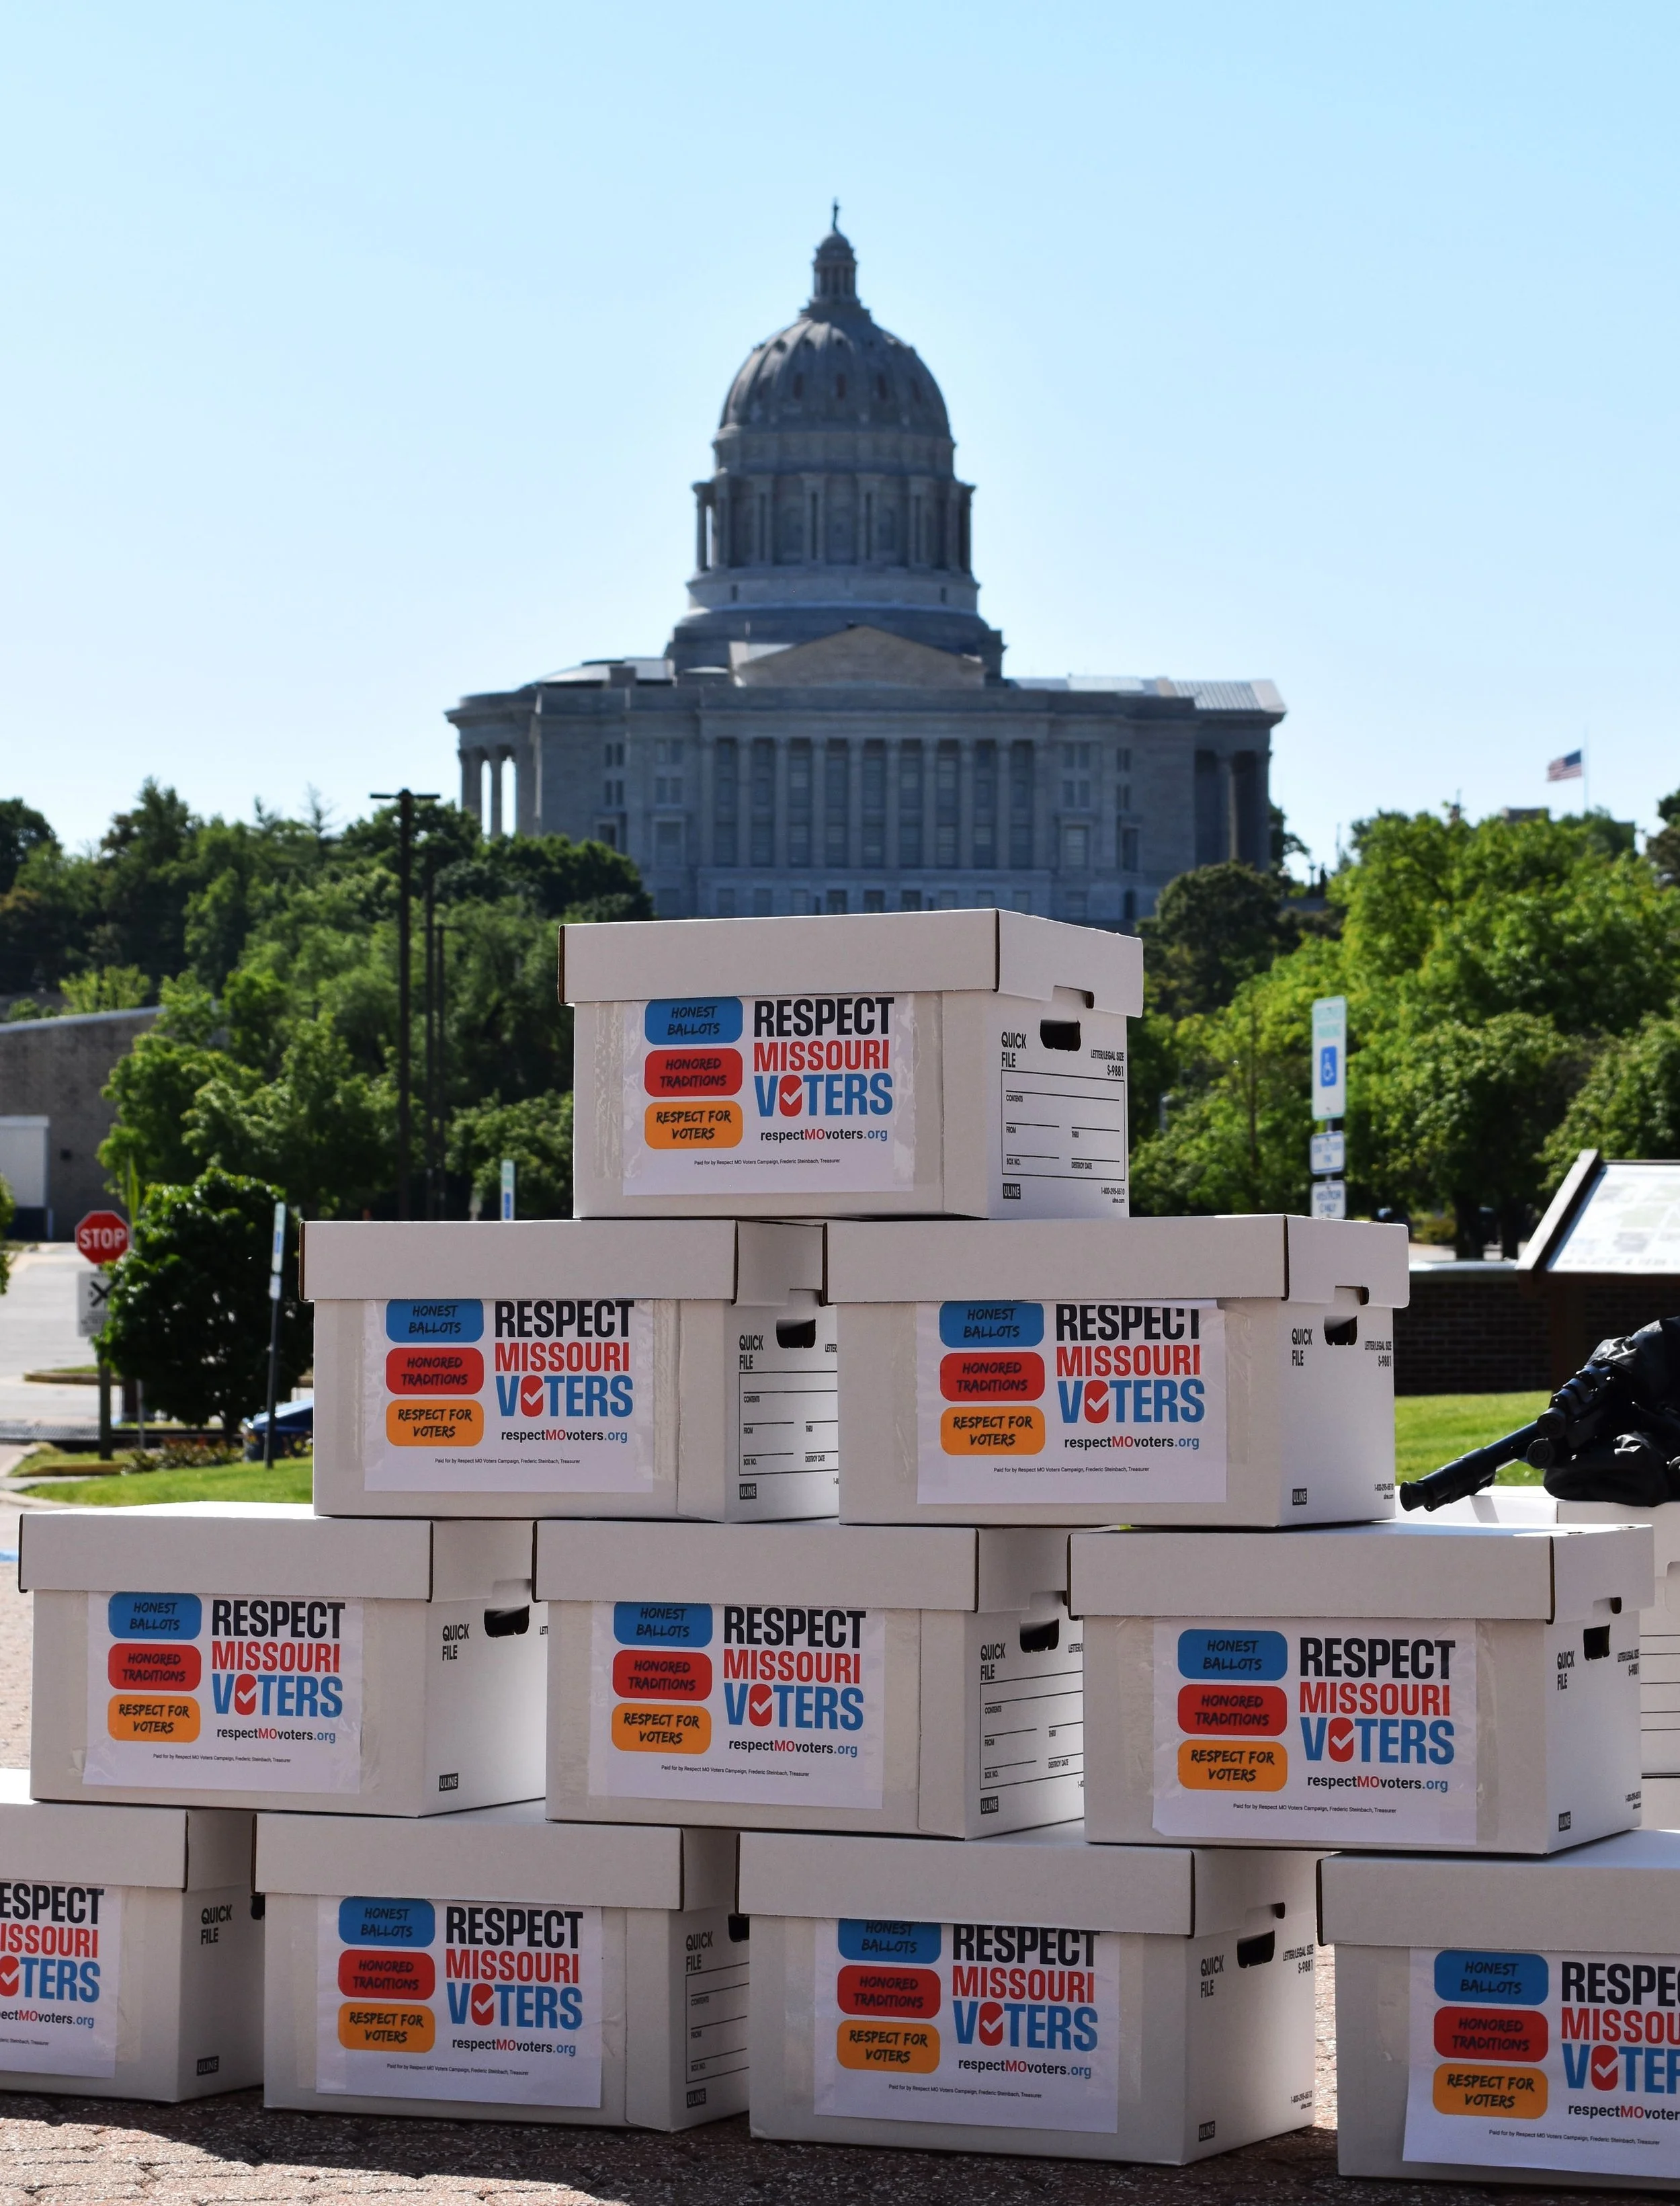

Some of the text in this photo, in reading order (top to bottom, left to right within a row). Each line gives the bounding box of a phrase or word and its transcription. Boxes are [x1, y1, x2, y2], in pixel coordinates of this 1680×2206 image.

[671, 1006, 718, 1018] HONEST
[754, 996, 894, 1038] RESPECT
[667, 1023, 720, 1036] BALLOTS
[1001, 1031, 1027, 1049] QUICK
[754, 1039, 889, 1072] MISSOURI
[1001, 1052, 1016, 1068] FILE
[1091, 1049, 1124, 1061] LETTER/LEGAL SIZE
[665, 1058, 722, 1071] HONORED
[1107, 1065, 1124, 1077] S-9881
[660, 1075, 726, 1090] TRADITIONS
[754, 1072, 893, 1117] VOTERS
[1006, 1094, 1023, 1102] CONTENTS
[656, 1110, 731, 1124] RESPECT FOR
[671, 1127, 714, 1140] VOTERS
[760, 1129, 887, 1141] respectMOvoters.org
[1003, 1185, 1020, 1197] ULINE
[79, 1228, 126, 1250] STOP
[413, 1305, 459, 1317] HONEST
[495, 1300, 634, 1338] RESPECT
[968, 1307, 1017, 1321] HONEST
[409, 1322, 461, 1334] BALLOTS
[964, 1325, 1020, 1338] BALLOTS
[739, 1335, 763, 1351] QUICK
[1292, 1328, 1312, 1346] QUICK
[407, 1357, 462, 1369] HONORED
[495, 1342, 629, 1372] MISSOURI
[739, 1354, 753, 1370] FILE
[1056, 1344, 1200, 1377] MISSOURI
[1292, 1350, 1304, 1366] FILE
[962, 1362, 1022, 1375] HONORED
[401, 1374, 468, 1387] TRADITIONS
[956, 1379, 1027, 1393] TRADITIONS
[495, 1375, 633, 1418] VOTERS
[1056, 1379, 1205, 1424] VOTERS
[397, 1409, 472, 1422] RESPECT FOR
[953, 1416, 1033, 1430] RESPECT FOR
[413, 1426, 456, 1438] VOTERS
[501, 1429, 627, 1443] respectMOvoters.org
[969, 1434, 1015, 1446] VOTERS
[1064, 1436, 1200, 1450] respectMOvoters.org
[740, 1486, 756, 1497] ULINE
[1293, 1491, 1307, 1503] ULINE
[134, 1602, 178, 1615] HONEST
[640, 1608, 687, 1621] HONEST
[130, 1619, 180, 1631] BALLOTS
[212, 1599, 345, 1639] RESPECT
[442, 1623, 470, 1641] QUICK
[636, 1625, 689, 1638] BALLOTS
[724, 1606, 866, 1649] RESPECT
[442, 1645, 458, 1661] FILE
[980, 1643, 1006, 1661] QUICK
[1208, 1639, 1259, 1653] HONEST
[128, 1653, 181, 1666] HONORED
[211, 1641, 339, 1673] MISSOURI
[1203, 1658, 1262, 1671] BALLOTS
[1300, 1637, 1456, 1680] RESPECT
[1557, 1650, 1575, 1670] QUICK
[634, 1660, 691, 1674] HONORED
[723, 1649, 860, 1684] MISSOURI
[980, 1664, 995, 1680] FILE
[122, 1669, 185, 1682] TRADITIONS
[1557, 1673, 1567, 1690] FILE
[628, 1676, 696, 1692] TRADITIONS
[211, 1674, 342, 1718] VOTERS
[1201, 1695, 1263, 1709] HONORED
[1300, 1682, 1450, 1716] MISSOURI
[118, 1703, 190, 1718] RESPECT FOR
[723, 1682, 864, 1731] VOTERS
[133, 1721, 173, 1734] VOTERS
[623, 1712, 700, 1729] RESPECT FOR
[1195, 1712, 1269, 1727] TRADITIONS
[216, 1728, 336, 1744] respectMOvoters.org
[639, 1731, 683, 1745] VOTERS
[1300, 1717, 1454, 1765] VOTERS
[728, 1740, 857, 1758] respectMOvoters.org
[1191, 1749, 1275, 1765] RESPECT FOR
[439, 1776, 458, 1789] ULINE
[1208, 1768, 1256, 1783] VOTERS
[1307, 1776, 1448, 1793] respectMOvoters.org
[981, 1798, 998, 1811] ULINE
[201, 1905, 232, 1924] QUICK
[365, 1908, 410, 1921] HONEST
[361, 1924, 413, 1938] BALLOTS
[446, 1906, 584, 1949] RESPECT
[866, 1923, 915, 1936] HONEST
[201, 1928, 218, 1945] FILE
[685, 1930, 713, 1951] QUICK
[862, 1939, 917, 1954] BALLOTS
[953, 1926, 1100, 1967] RESPECT
[359, 1960, 414, 1973] HONORED
[446, 1949, 579, 1984] MISSOURI
[685, 1954, 702, 1972] FILE
[1200, 1955, 1224, 1977] QUICK
[1466, 1961, 1519, 1977] HONEST
[353, 1976, 419, 1991] TRADITIONS
[859, 1976, 919, 1991] HONORED
[952, 1965, 1095, 2003] MISSOURI
[1201, 1979, 1214, 1998] FILE
[1460, 1979, 1522, 1994] BALLOTS
[446, 1982, 582, 2030] VOTERS
[853, 1993, 923, 2009] TRADITIONS
[349, 2011, 423, 2028] RESPECT FOR
[952, 2000, 1098, 2051] VOTERS
[1458, 2018, 1523, 2033] HONORED
[365, 2030, 407, 2044] VOTERS
[849, 2029, 928, 2047] RESPECT FOR
[1452, 2035, 1529, 2052] TRADITIONS
[452, 2039, 577, 2056] respectMOvoters.org
[865, 2049, 911, 2064] VOTERS
[198, 2059, 218, 2072] ULINE
[958, 2059, 1091, 2079] respectMOvoters.org
[1447, 2074, 1534, 2092] RESPECT FOR
[1465, 2093, 1515, 2109] VOTERS
